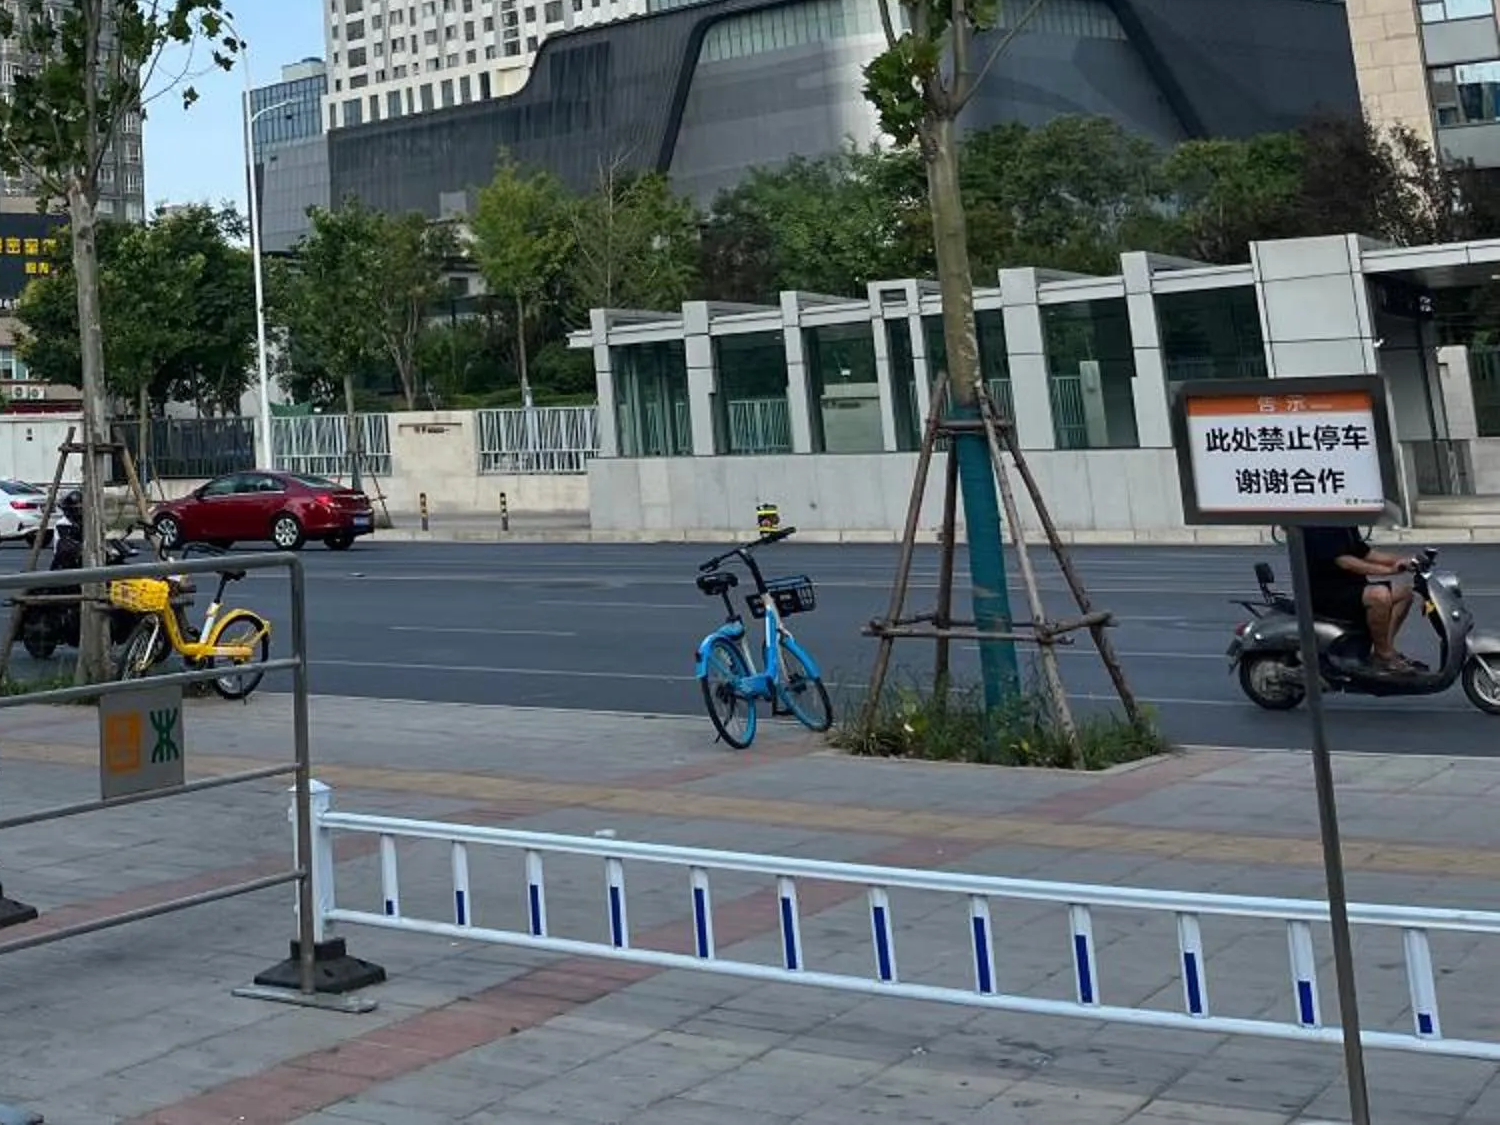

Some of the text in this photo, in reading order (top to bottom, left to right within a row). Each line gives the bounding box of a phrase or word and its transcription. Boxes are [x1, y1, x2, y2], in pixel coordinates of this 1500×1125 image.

[1257, 395, 1307, 412] 告示
[1205, 424, 1370, 453] 此处禁止停车
[1235, 468, 1346, 495] 谢谢合作
